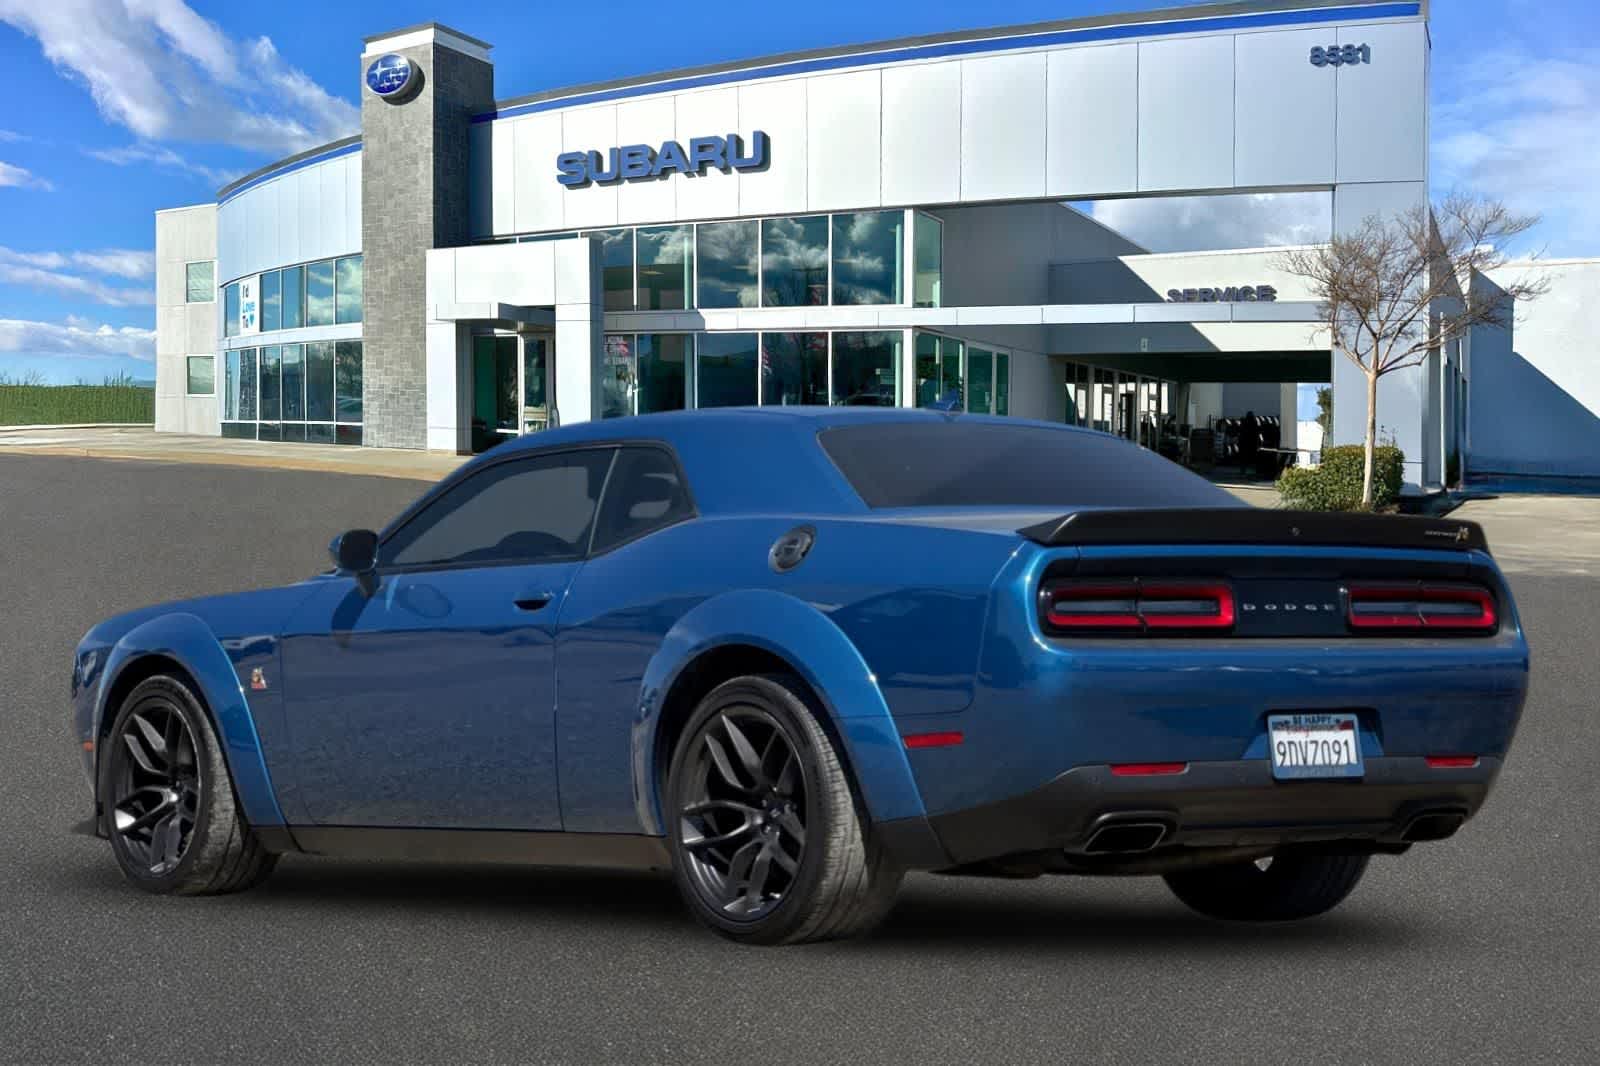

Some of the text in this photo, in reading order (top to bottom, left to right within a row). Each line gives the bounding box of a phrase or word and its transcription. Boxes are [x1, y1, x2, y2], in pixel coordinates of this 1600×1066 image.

[1309, 43, 1370, 66] 8581
[557, 130, 770, 189] SUBARU
[1166, 285, 1277, 303] SERVICE
[1277, 739, 1351, 767] 9DV7091
